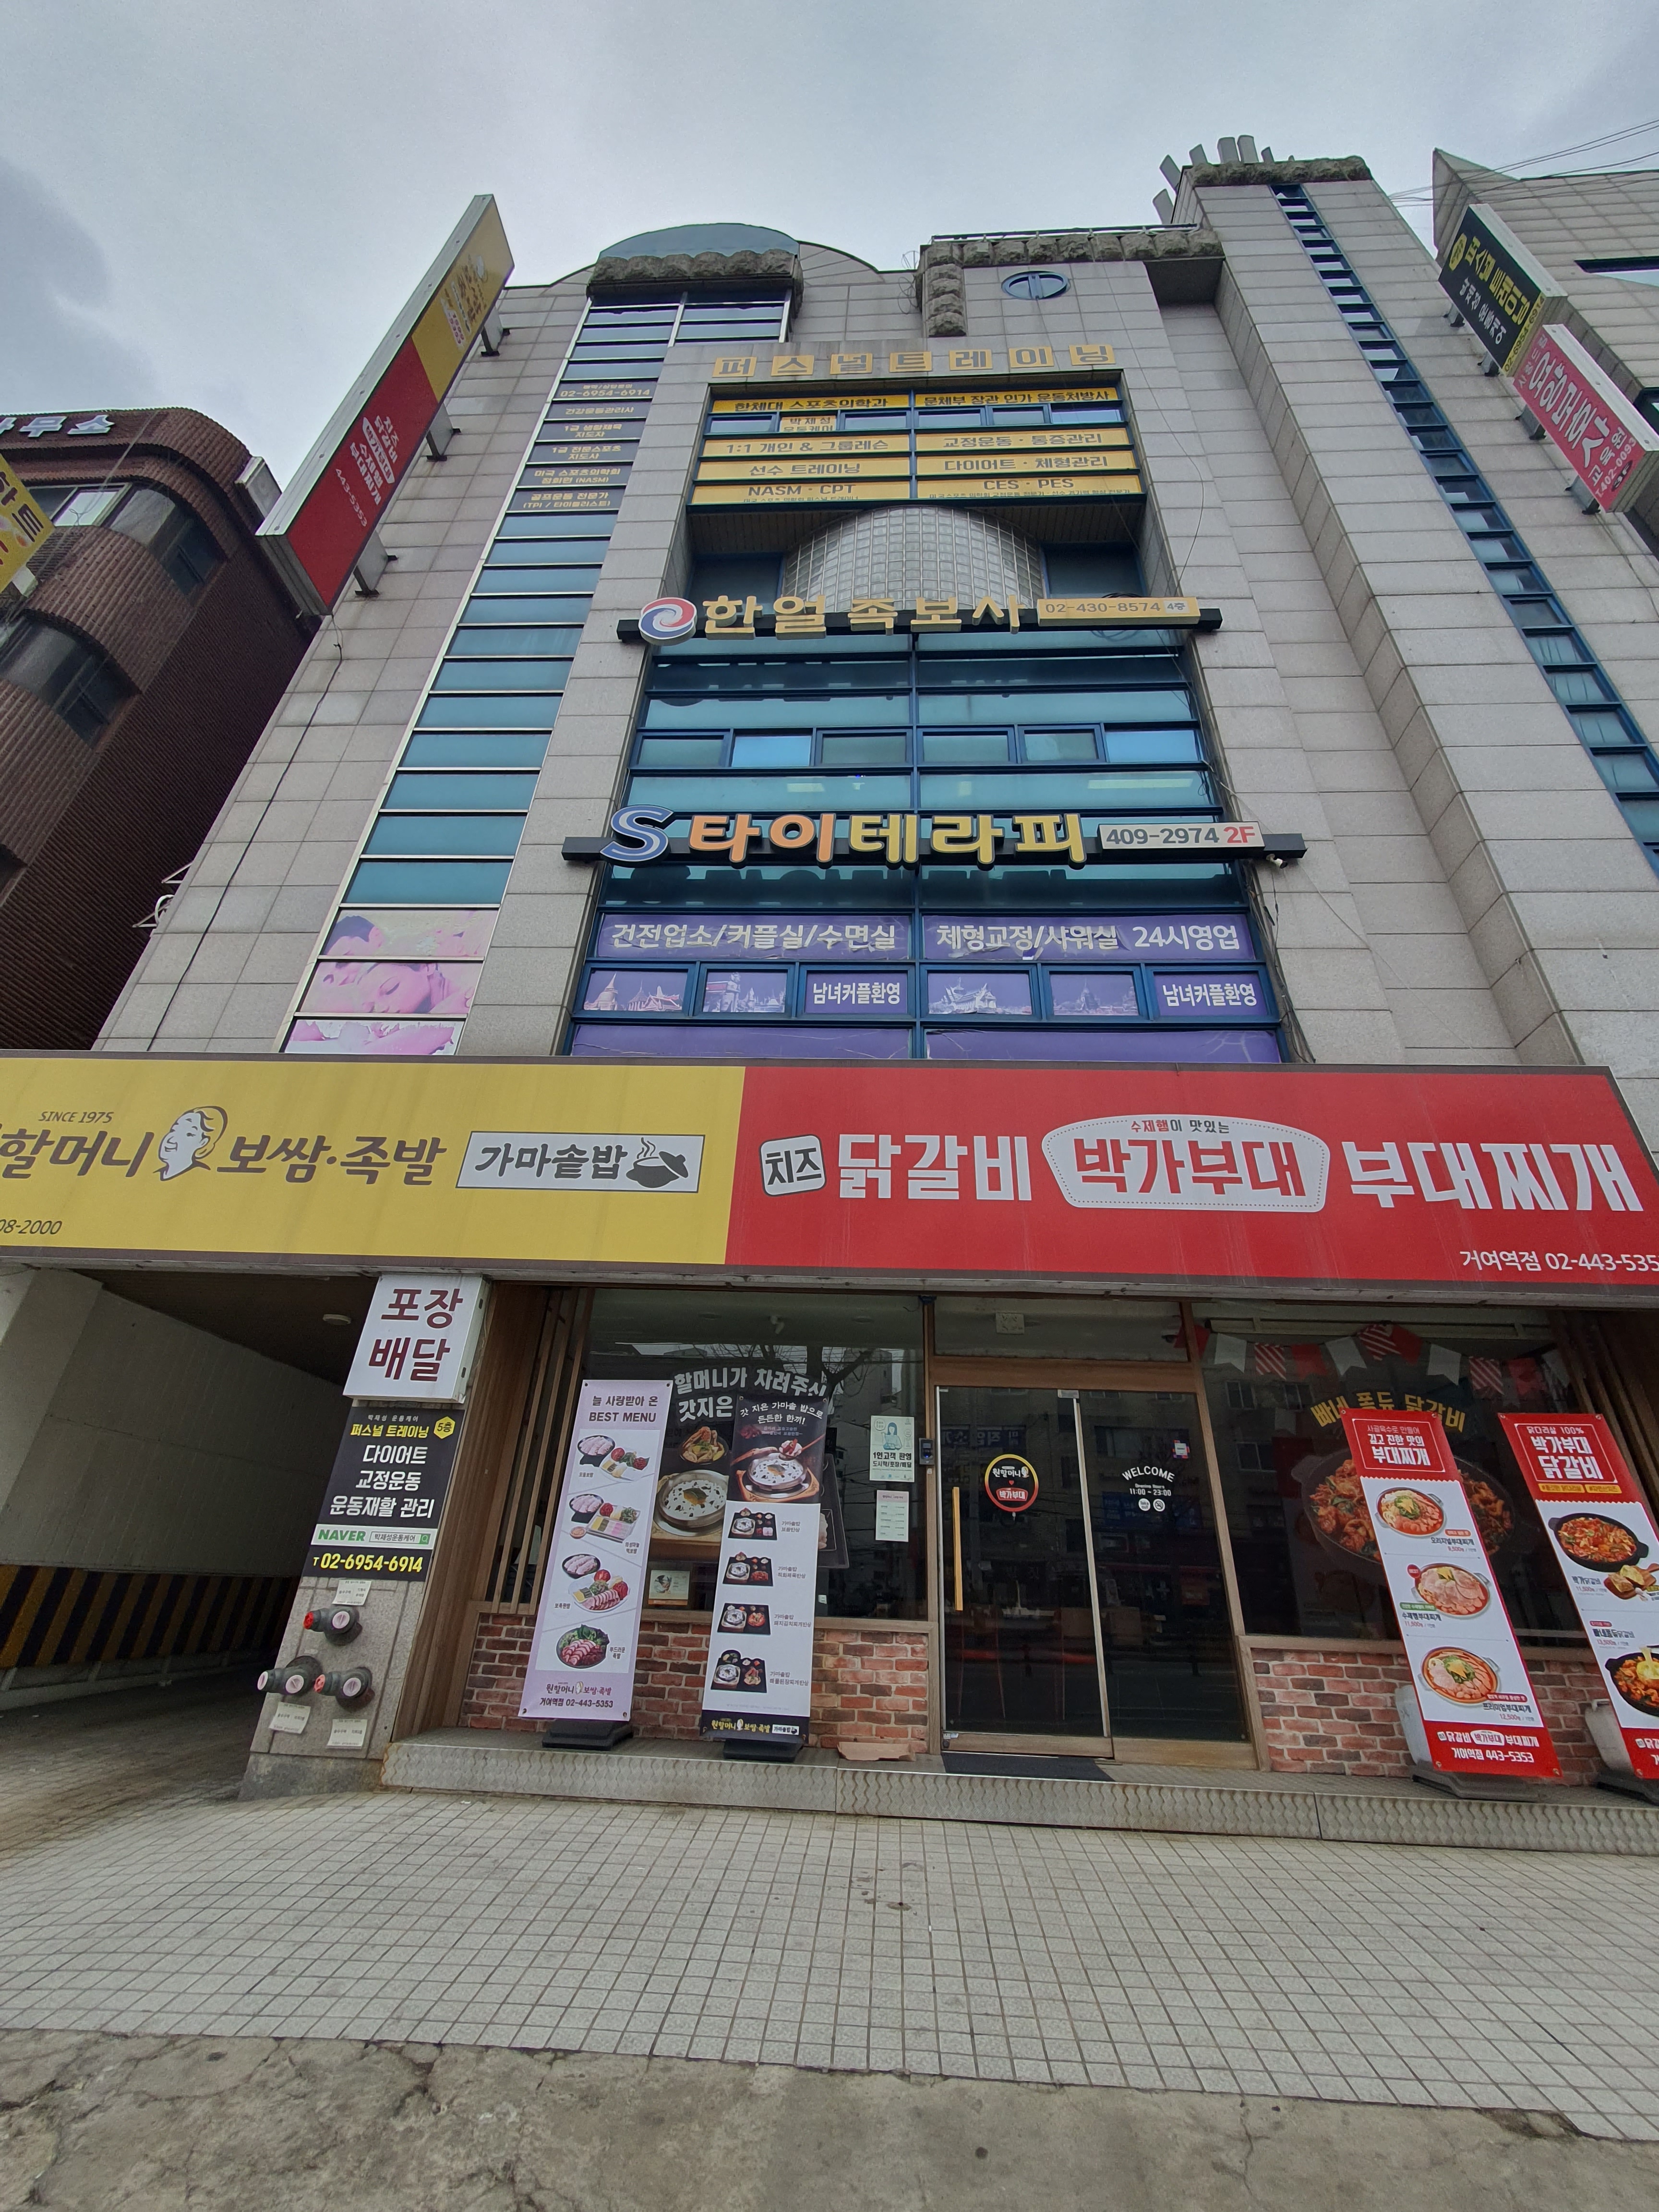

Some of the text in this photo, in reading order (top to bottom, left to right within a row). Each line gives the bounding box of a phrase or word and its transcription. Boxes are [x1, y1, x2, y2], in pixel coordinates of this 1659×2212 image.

[734, 401, 783, 411] 한체대
[924, 397, 966, 406] 문체부
[971, 395, 999, 404] 장관
[1004, 394, 1032, 403] 인가
[1529, 351, 1610, 468] 요양보호사
[726, 443, 751, 453] 1:1
[760, 442, 793, 452] 개인
[943, 433, 1102, 447] 교정운동 통증관리
[749, 463, 860, 476] 선수 트레이닝
[945, 456, 1108, 471] 다이어트 체형관리
[748, 484, 856, 496] NASM CPT
[984, 478, 1074, 490] CES PES
[336, 469, 367, 527] 443-5353
[703, 595, 1024, 638] 한얼족보사
[1046, 602, 1161, 613] 02-430-8574
[1106, 827, 1255, 845] 409-2974 2F
[1132, 925, 1240, 950] 24시영업
[813, 982, 901, 1005] 남녀커플환영
[1162, 983, 1257, 1007] 남녀커플환영
[38, 1110, 114, 1124] SINCE 1975
[1131, 1119, 1230, 1134] 수제햄이 맛있는
[0, 1123, 155, 1179] 할머니
[474, 1143, 628, 1180] 가마솥밥
[765, 1134, 1034, 1201] 치즈 닭갈비
[1073, 1138, 1306, 1197] 박가부대
[1342, 1141, 1644, 1212] 부대찌개
[1459, 1250, 1542, 1272] 거여역점
[381, 1288, 464, 1329] 포장
[368, 1337, 451, 1382] 배달
[674, 1367, 748, 1395] 할머니가
[592, 1395, 658, 1407] 늘 사랑받아 온
[679, 1396, 733, 1422] 갓지은
[589, 1412, 657, 1422] BEST MENU
[758, 1414, 783, 1424] 든든한
[350, 1422, 452, 1439] 퍼스널 트레이닝 5층
[1530, 1436, 1593, 1455] 박가부대
[362, 1445, 428, 1465] 다이어트
[873, 1452, 896, 1460] 1인고객
[1372, 1446, 1431, 1466] 부대찌개
[992, 1468, 1021, 1478] 원할머니
[1122, 1466, 1175, 1482] WELCOME
[1538, 1455, 1604, 1479] 닭갈비
[355, 1470, 422, 1491] 교정운동
[999, 1491, 1025, 1500] 박가부대
[329, 1495, 435, 1518] 운동재활 관리
[318, 1529, 366, 1541] NAVER
[313, 1553, 423, 1573] T 02-6954-6914
[566, 1699, 613, 1707] 02-443-5353
[1486, 1750, 1535, 1763] 443-5353
